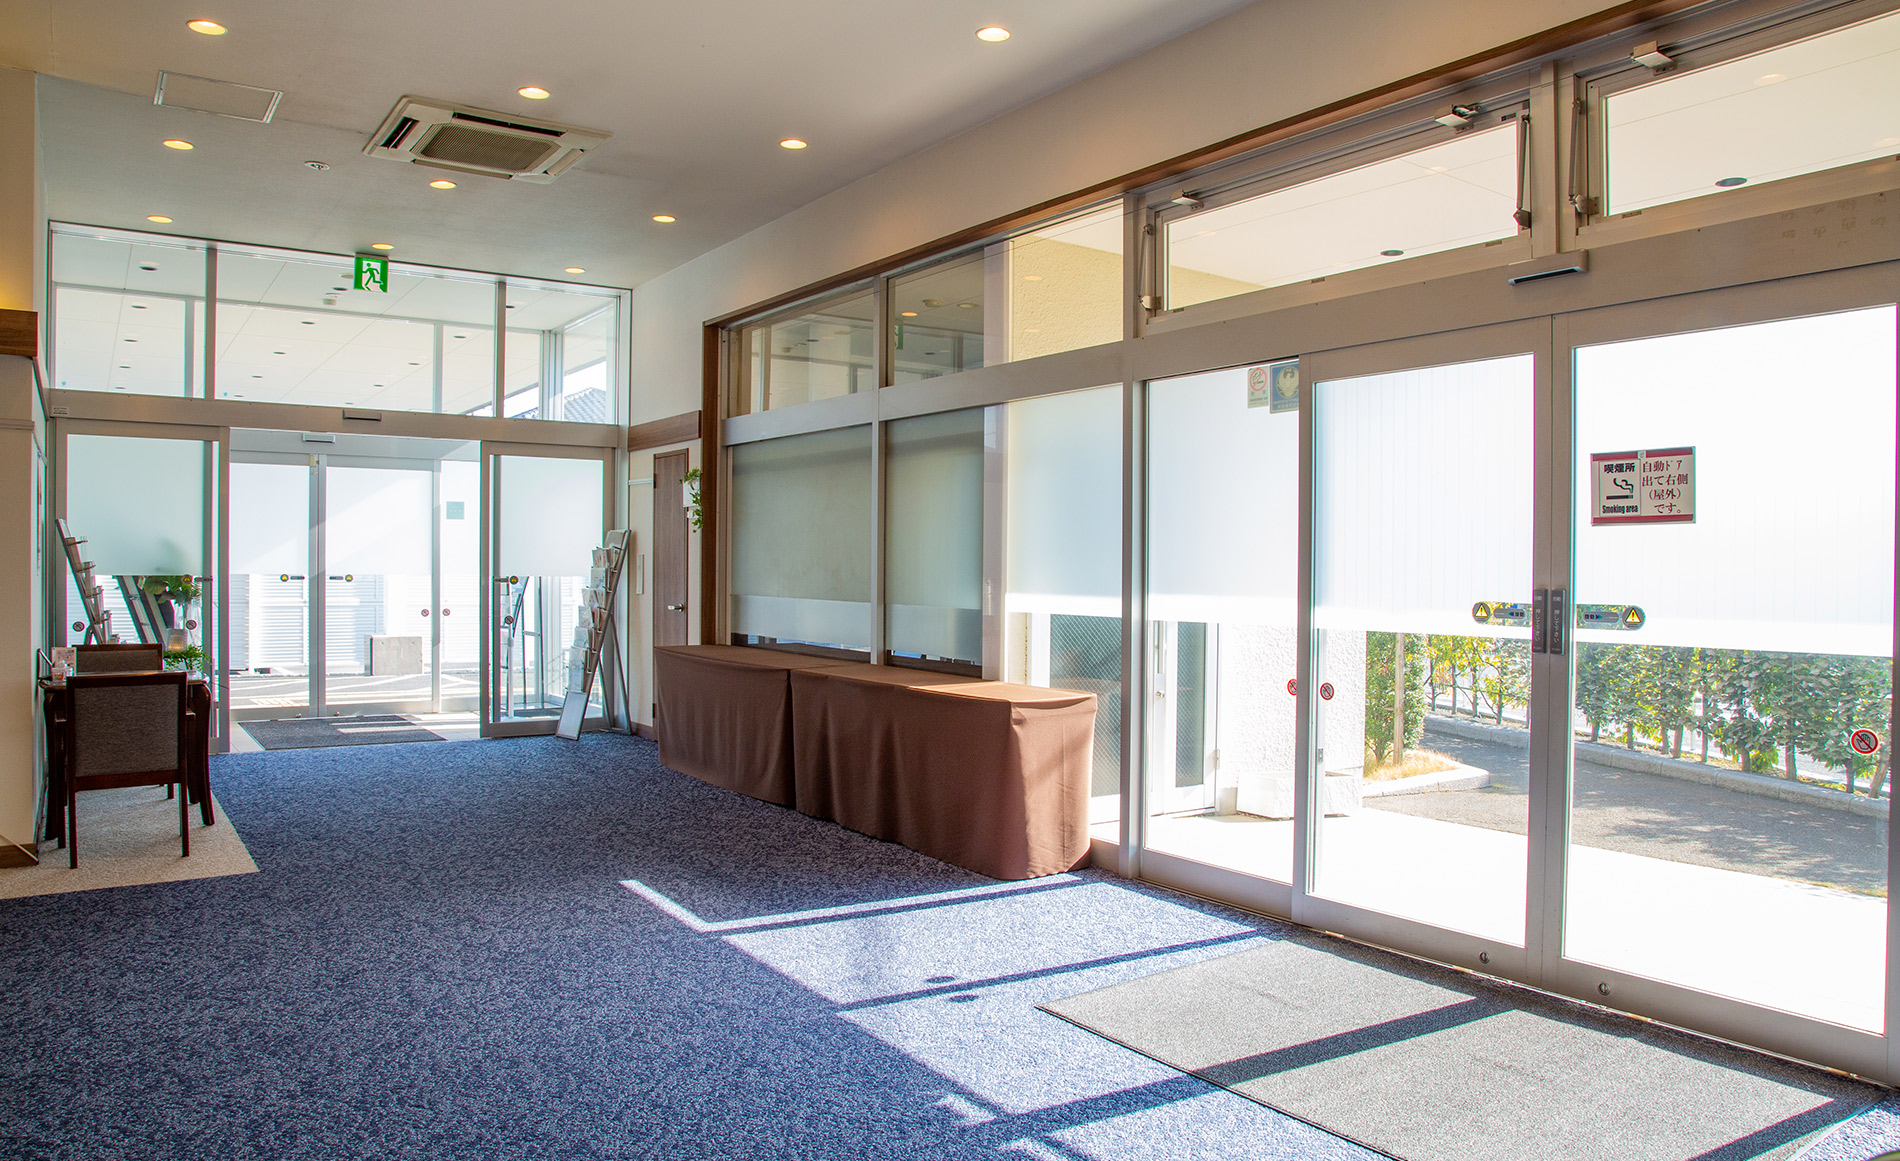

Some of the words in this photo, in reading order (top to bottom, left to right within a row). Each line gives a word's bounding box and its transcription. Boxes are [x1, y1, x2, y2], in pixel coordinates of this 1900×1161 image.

[1604, 463, 1635, 473] 喫煙所
[1642, 473, 1688, 486] 出て右側
[1602, 505, 1625, 514] Smoking
[1625, 505, 1638, 513] area
[1654, 502, 1681, 514] です。
